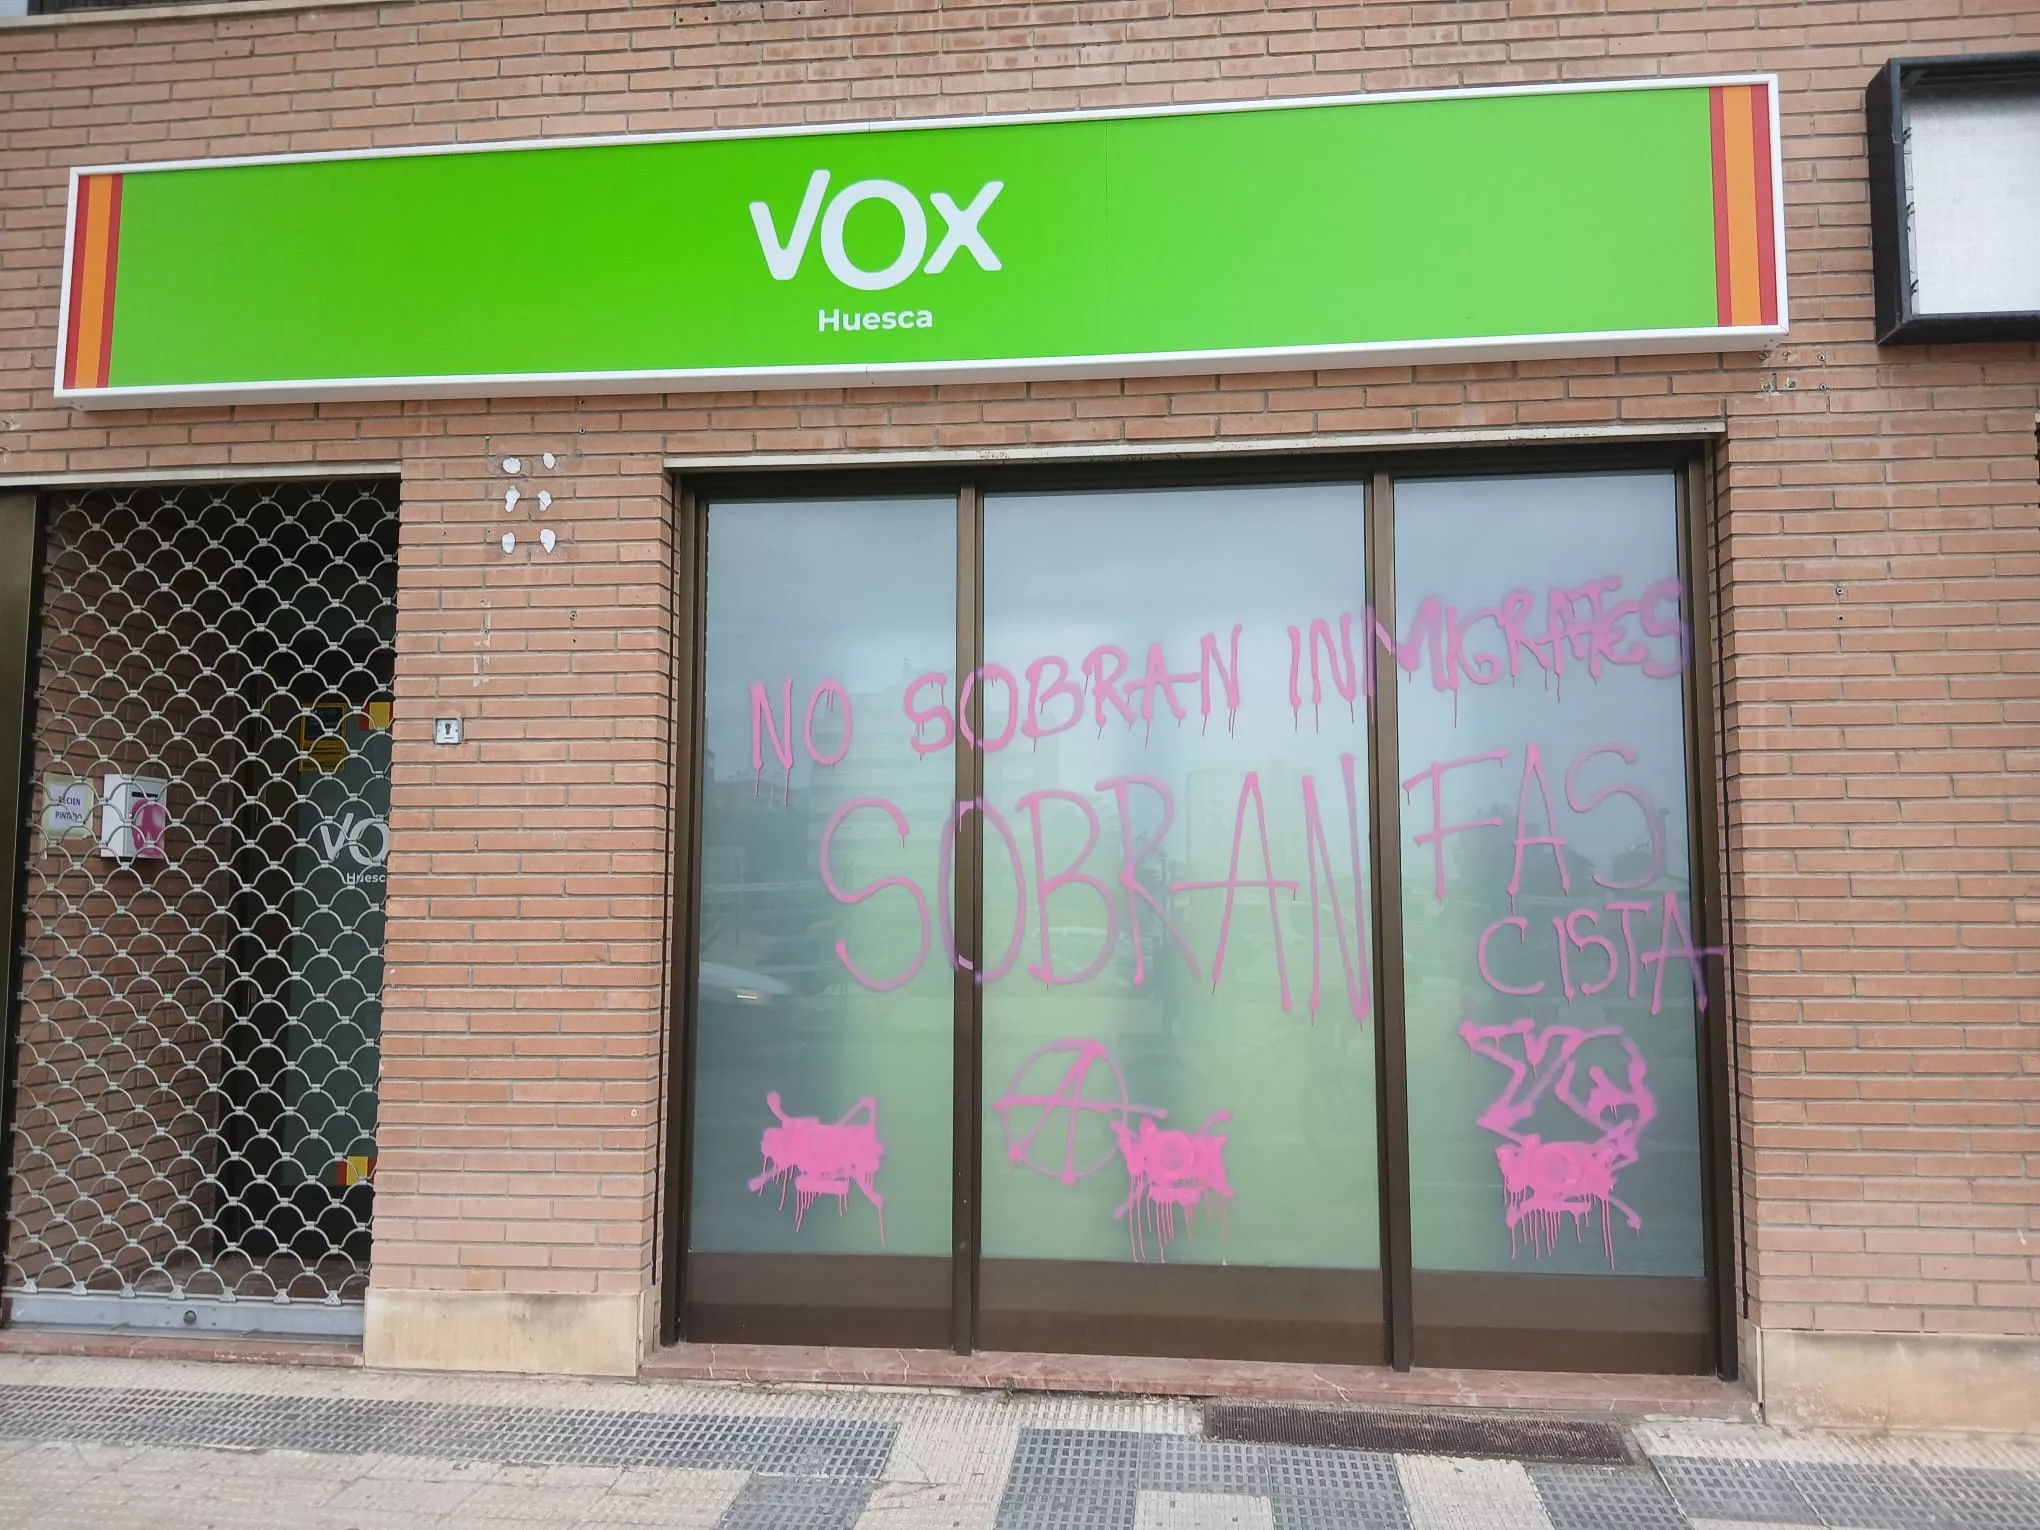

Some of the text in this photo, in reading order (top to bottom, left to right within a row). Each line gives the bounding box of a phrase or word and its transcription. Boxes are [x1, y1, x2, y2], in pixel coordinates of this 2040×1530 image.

[749, 169, 1004, 290] VOX
[818, 308, 933, 332] Huesca
[749, 678, 852, 770] NO
[903, 623, 1243, 760] SOBRAN
[820, 753, 1370, 1024] SOBRAN
[1402, 742, 1667, 902] FAS
[1477, 892, 1727, 1014] CISTA
